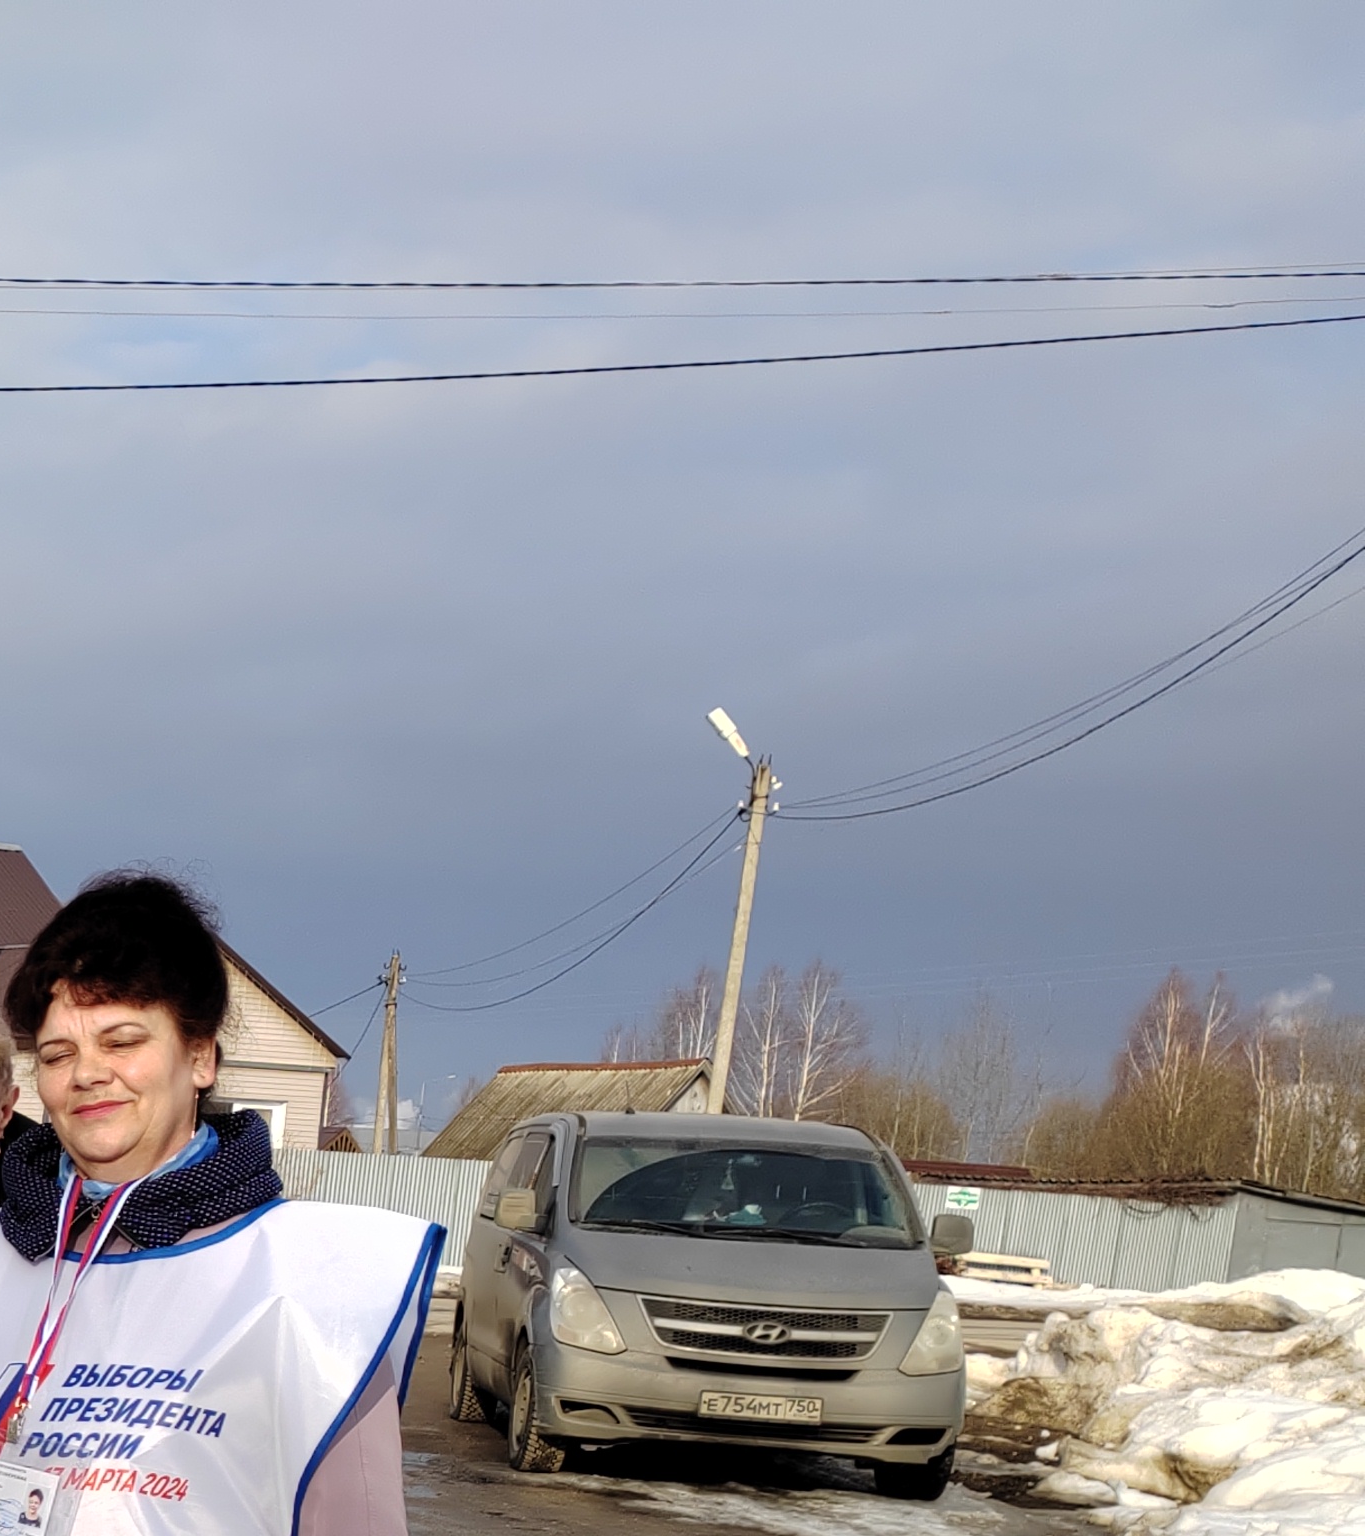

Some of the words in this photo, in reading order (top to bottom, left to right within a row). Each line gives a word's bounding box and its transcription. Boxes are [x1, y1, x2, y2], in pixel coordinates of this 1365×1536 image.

[61, 1363, 205, 1393] ВЫБОРЫ
[39, 1397, 227, 1438] ПРЕЗИДЕНТА
[19, 1431, 145, 1460] РОССИИ
[62, 1466, 138, 1493] МАРТА
[139, 1472, 190, 1502] 2024
